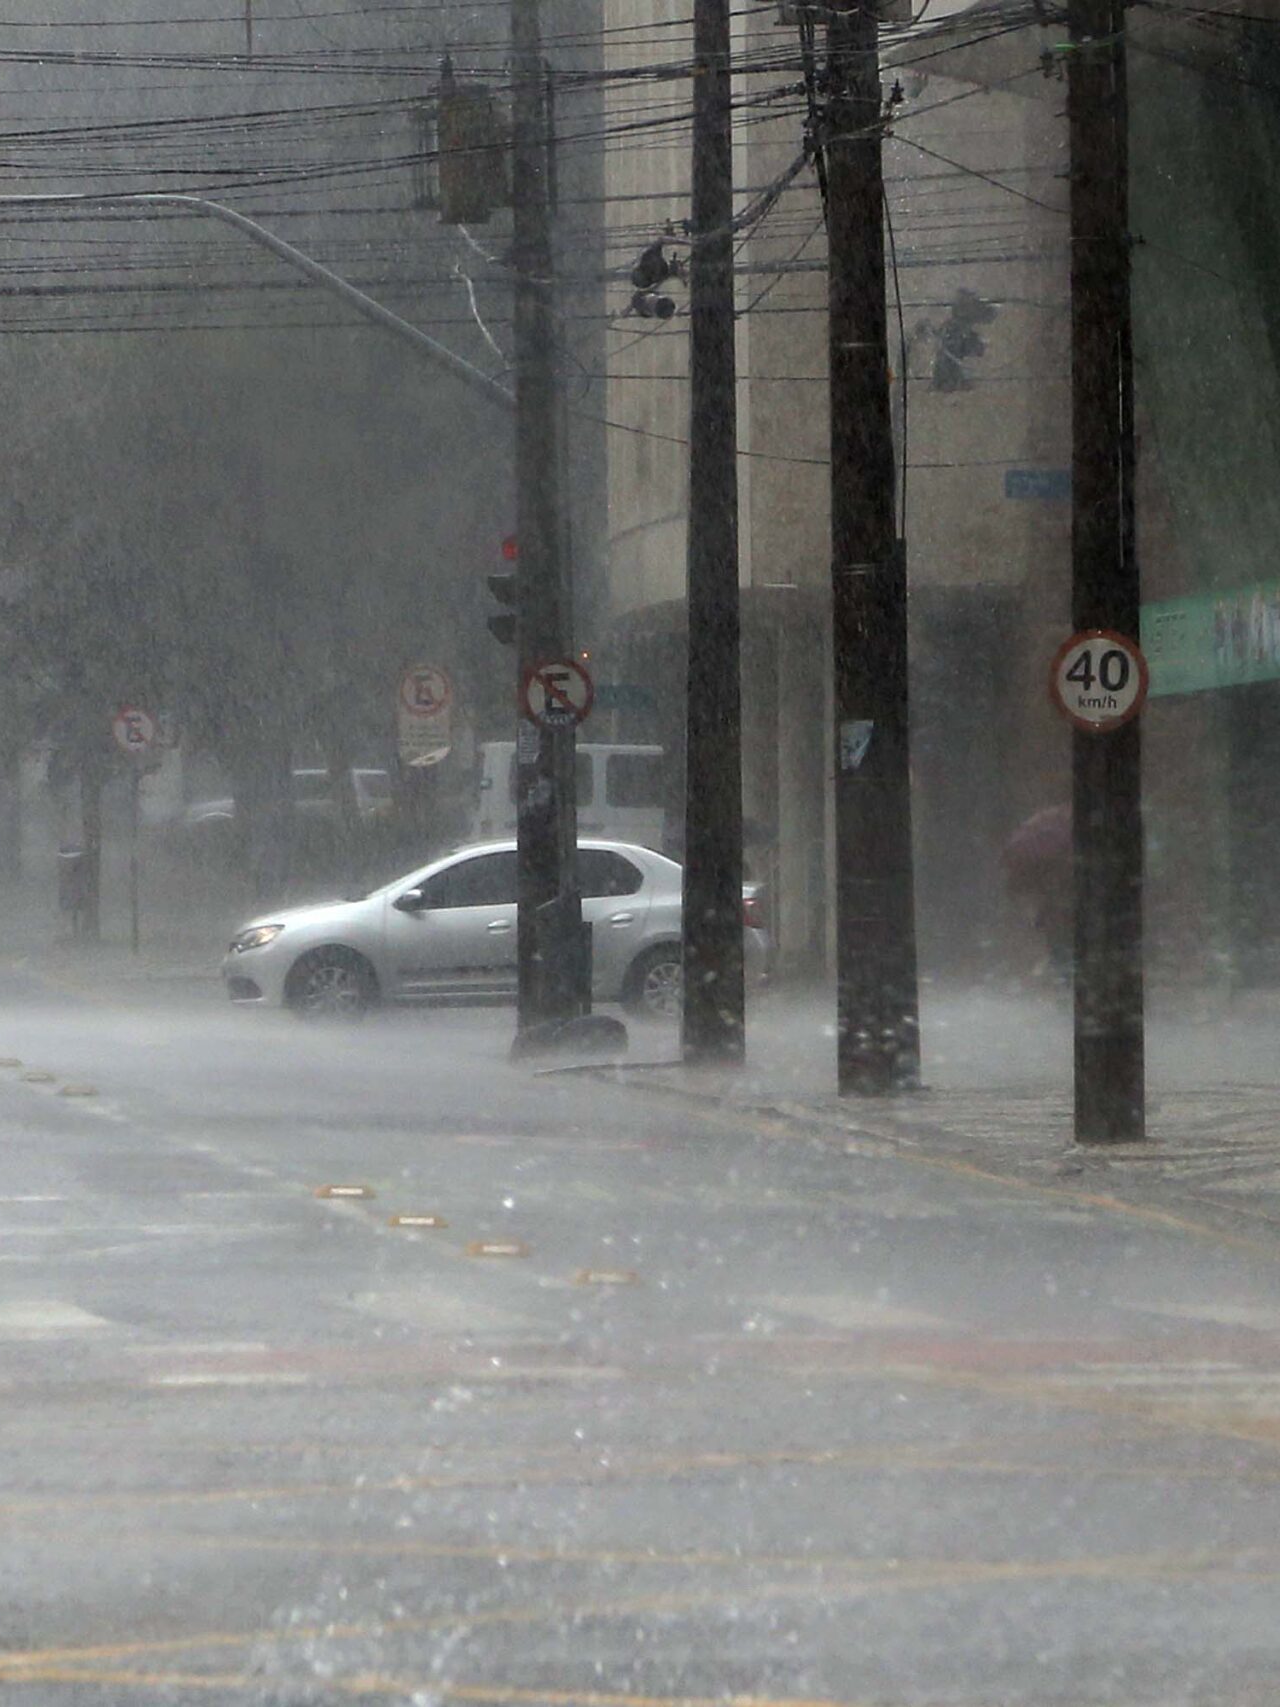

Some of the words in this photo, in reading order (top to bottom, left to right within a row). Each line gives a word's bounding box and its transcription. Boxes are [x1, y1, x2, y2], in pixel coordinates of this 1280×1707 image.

[1066, 650, 1129, 691] 40
[545, 672, 570, 713] E
[1078, 696, 1117, 709] km/h
